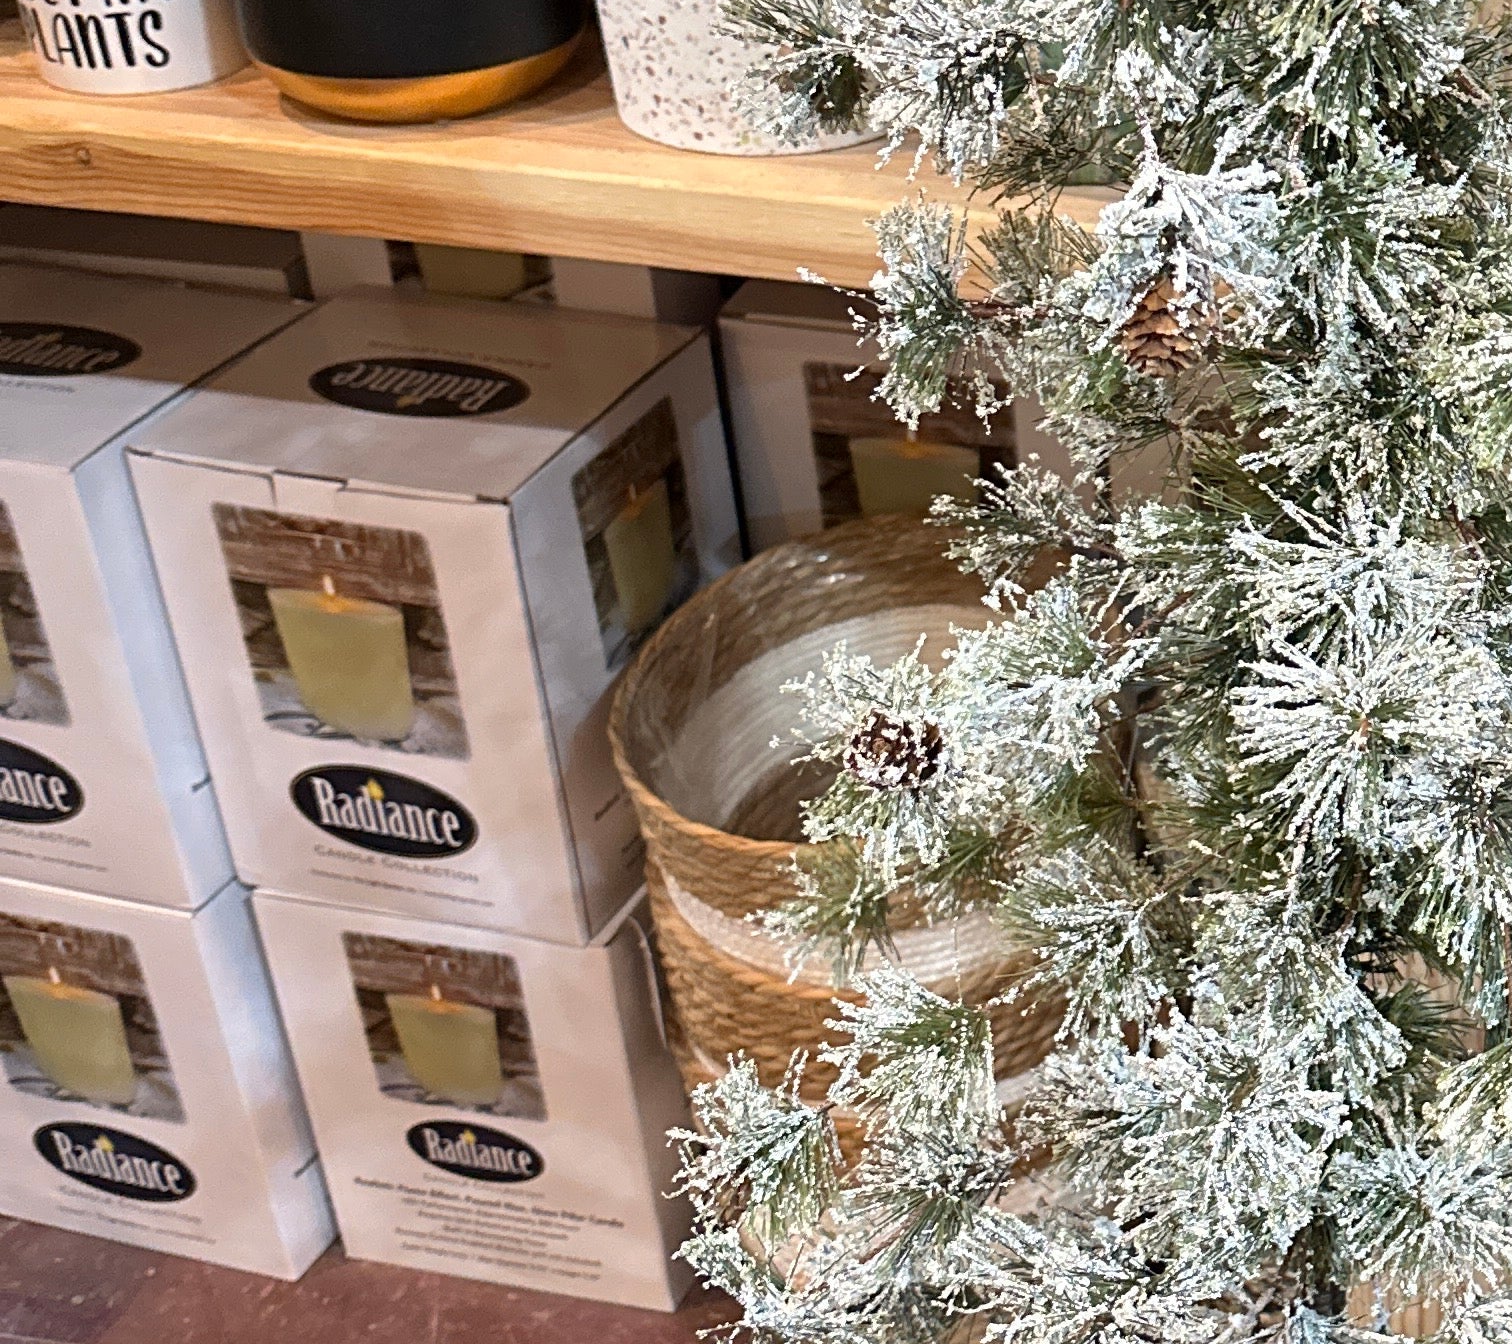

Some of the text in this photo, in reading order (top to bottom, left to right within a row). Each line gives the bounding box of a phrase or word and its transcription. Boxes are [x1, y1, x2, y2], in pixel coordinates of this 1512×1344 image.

[309, 775, 463, 848] Radiance
[51, 1129, 187, 1195] Radiance
[421, 1127, 534, 1177] Radiance
